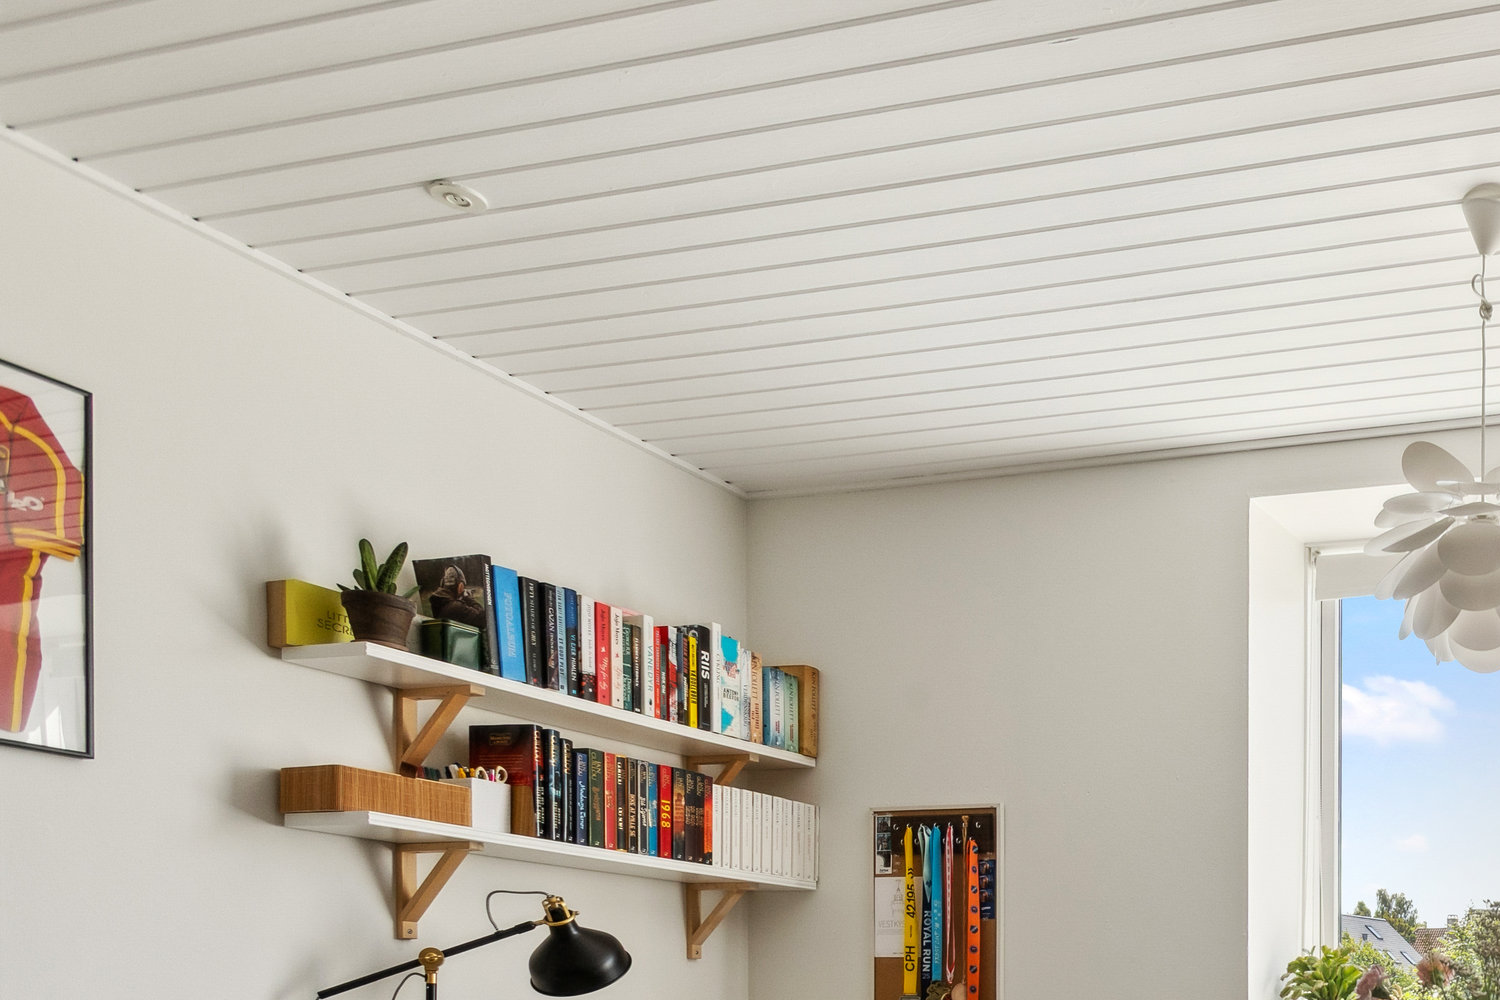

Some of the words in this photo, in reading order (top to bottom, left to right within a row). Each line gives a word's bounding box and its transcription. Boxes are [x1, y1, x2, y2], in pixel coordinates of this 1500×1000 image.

[326, 610, 349, 624] LITT
[503, 592, 516, 657] FOTOALBUM
[700, 650, 710, 680] RIIS
[577, 781, 587, 810] Madame
[660, 799, 671, 828] 1968
[923, 910, 932, 946] ROYAL
[904, 945, 916, 972] CPH
[922, 948, 932, 971] RUN
